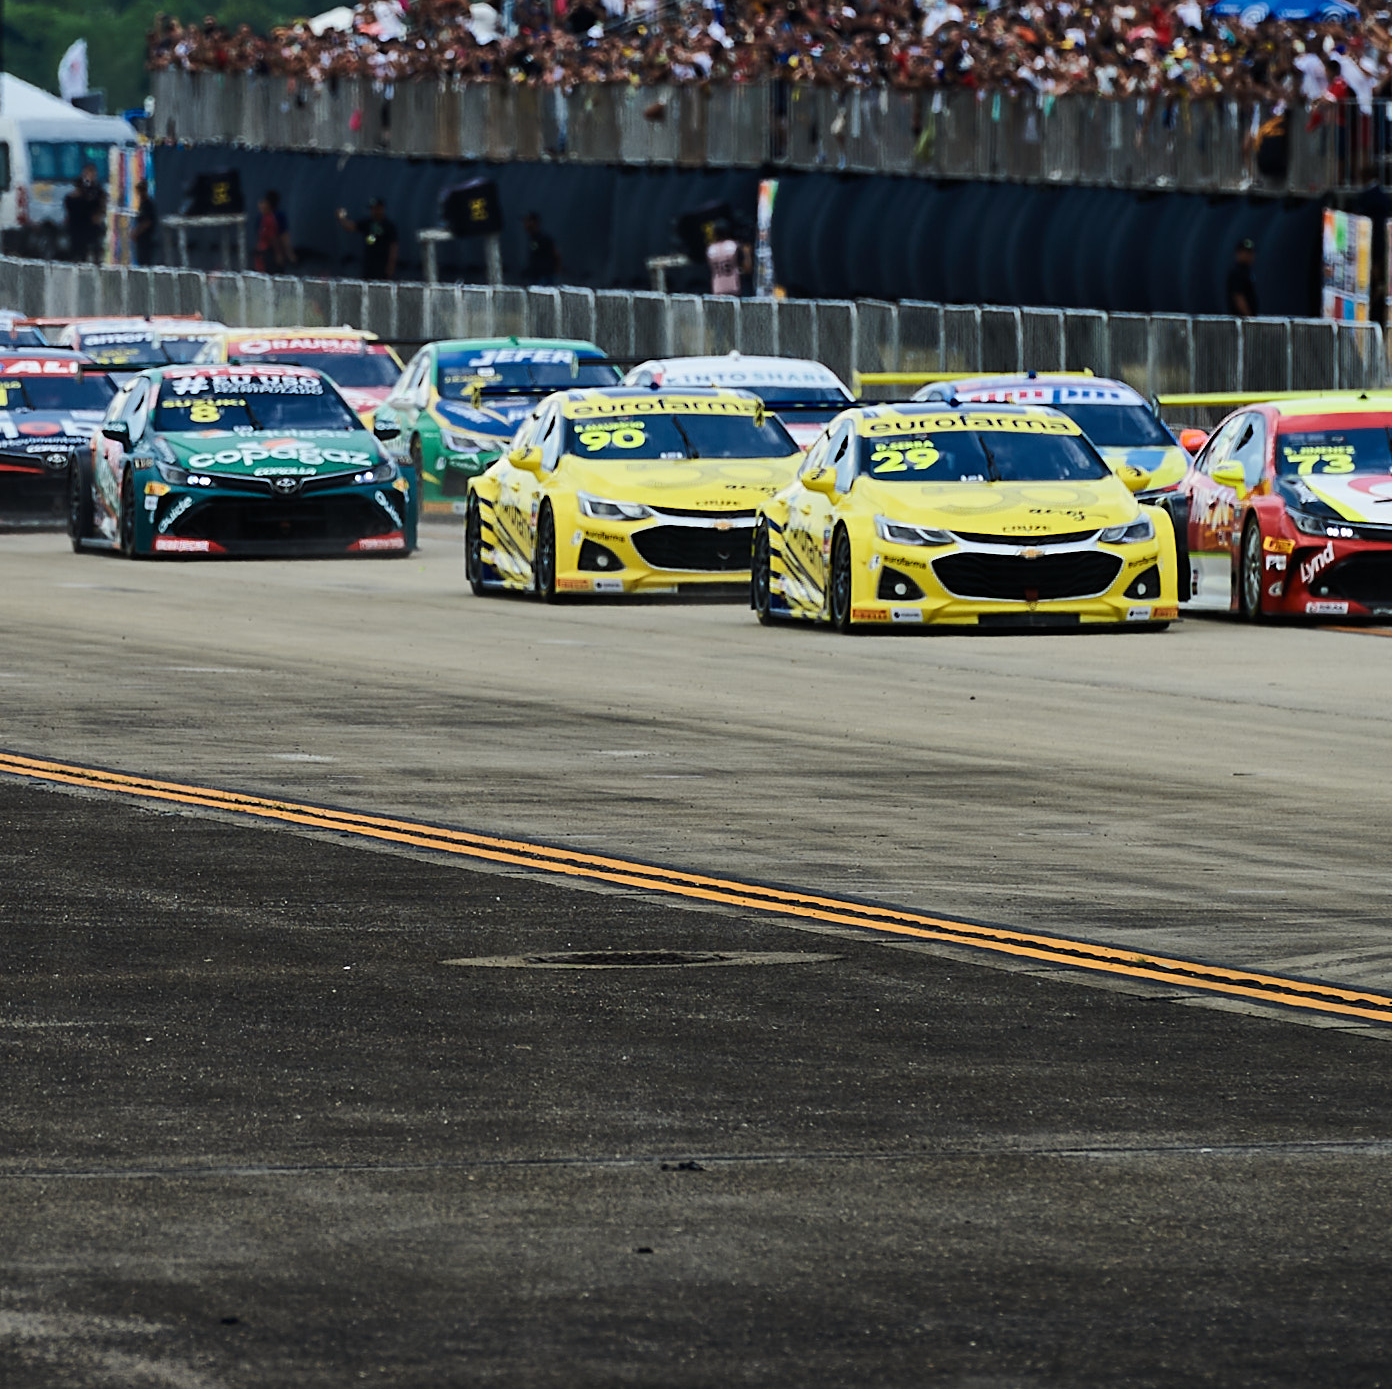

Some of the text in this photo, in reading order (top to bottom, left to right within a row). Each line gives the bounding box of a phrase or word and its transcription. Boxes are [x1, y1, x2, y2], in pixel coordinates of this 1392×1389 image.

[259, 374, 321, 386] USO
[666, 370, 834, 386] KINTO SHARE
[162, 398, 247, 409] SUZUKI
[189, 404, 221, 422] 8
[574, 398, 761, 415] eurofarma
[870, 413, 1070, 433] eurofarma
[579, 428, 646, 452] 90
[188, 448, 372, 467] copagaz
[871, 447, 940, 474] 29
[1287, 453, 1356, 476] 73
[1300, 541, 1335, 584] Lynd
